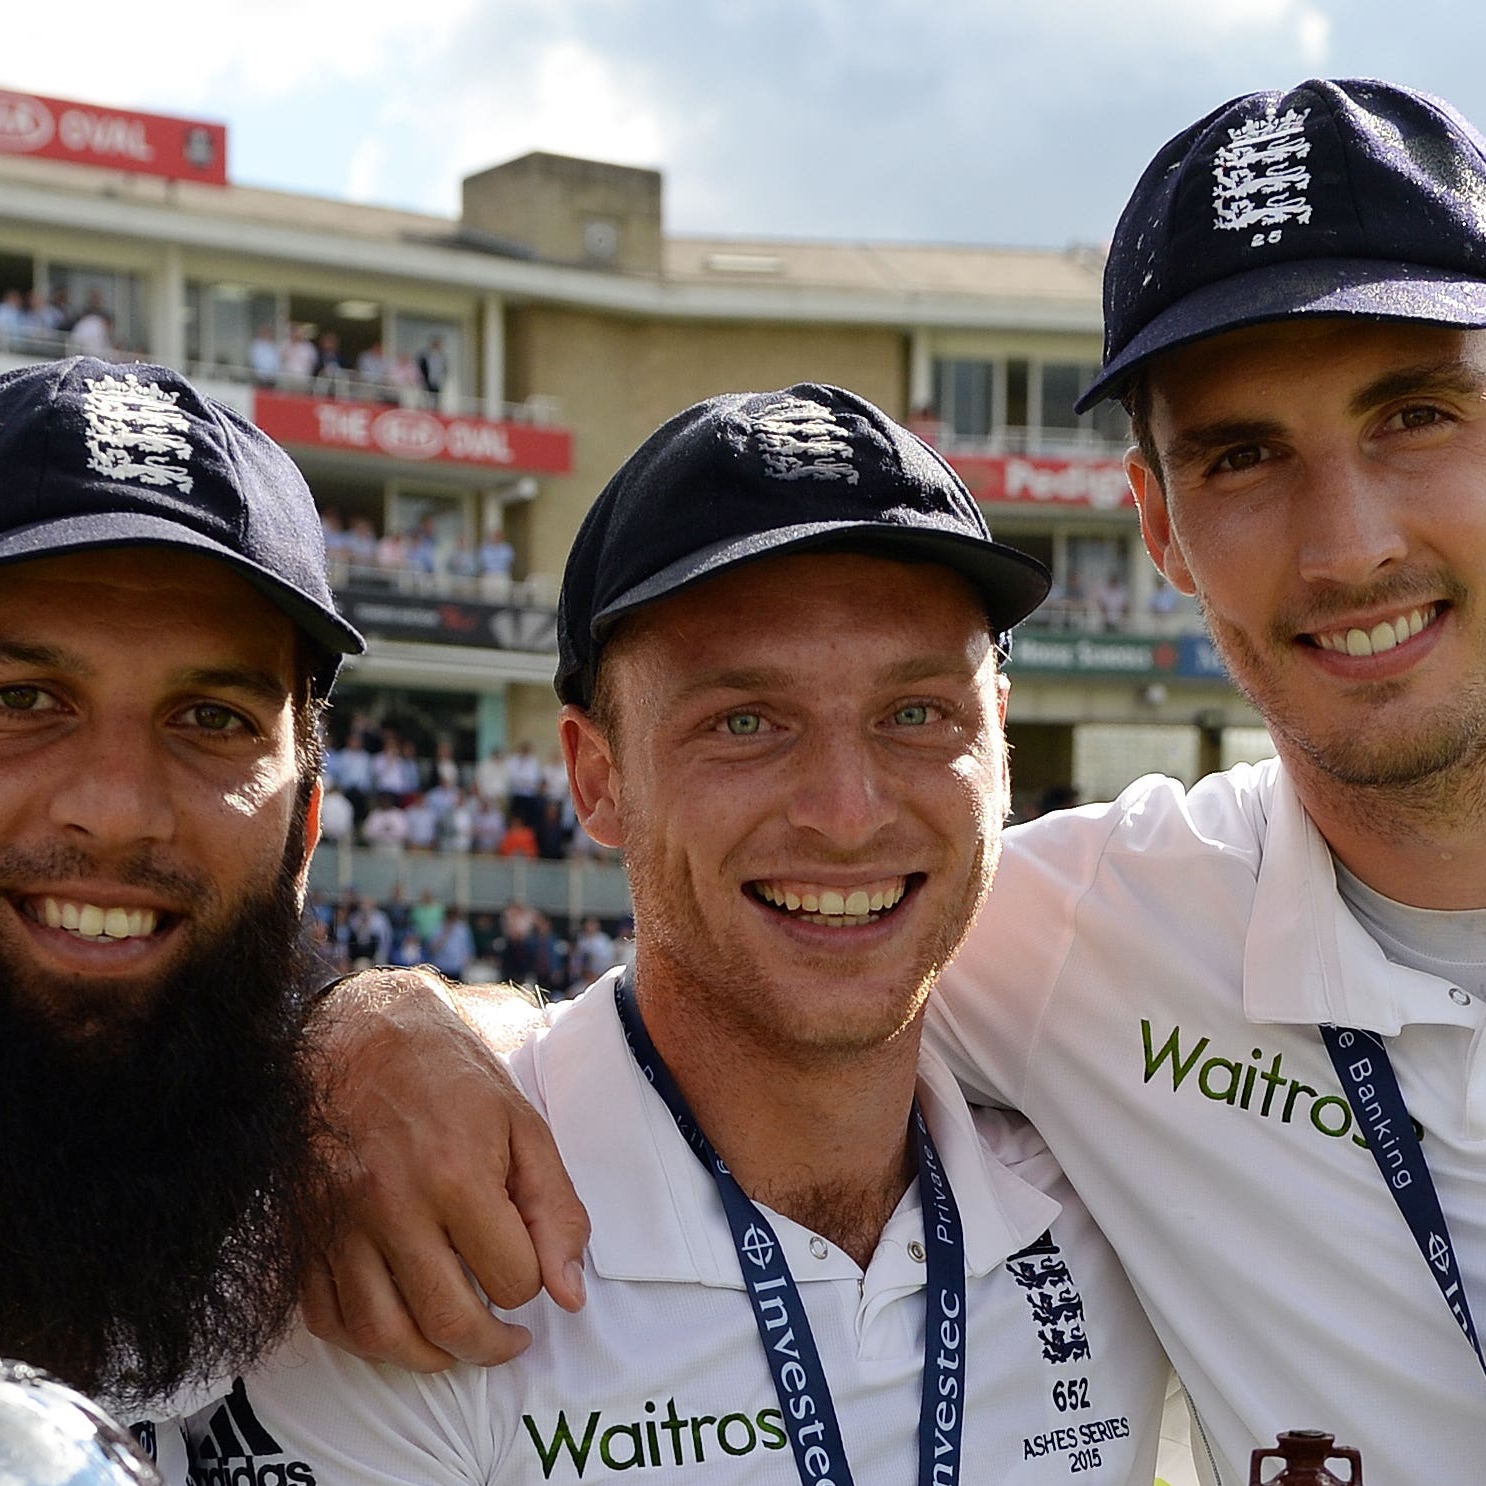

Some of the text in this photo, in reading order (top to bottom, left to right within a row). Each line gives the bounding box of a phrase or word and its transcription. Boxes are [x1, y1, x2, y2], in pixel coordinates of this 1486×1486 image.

[1141, 1018, 1424, 1151] Waitro
[1348, 1057, 1413, 1189] Banking
[923, 1144, 954, 1244] Private
[1053, 1377, 1090, 1412] 652
[522, 1396, 787, 1480] Waitros
[1023, 1417, 1130, 1460] ASHES SERIES
[1068, 1448, 1102, 1473] 2015
